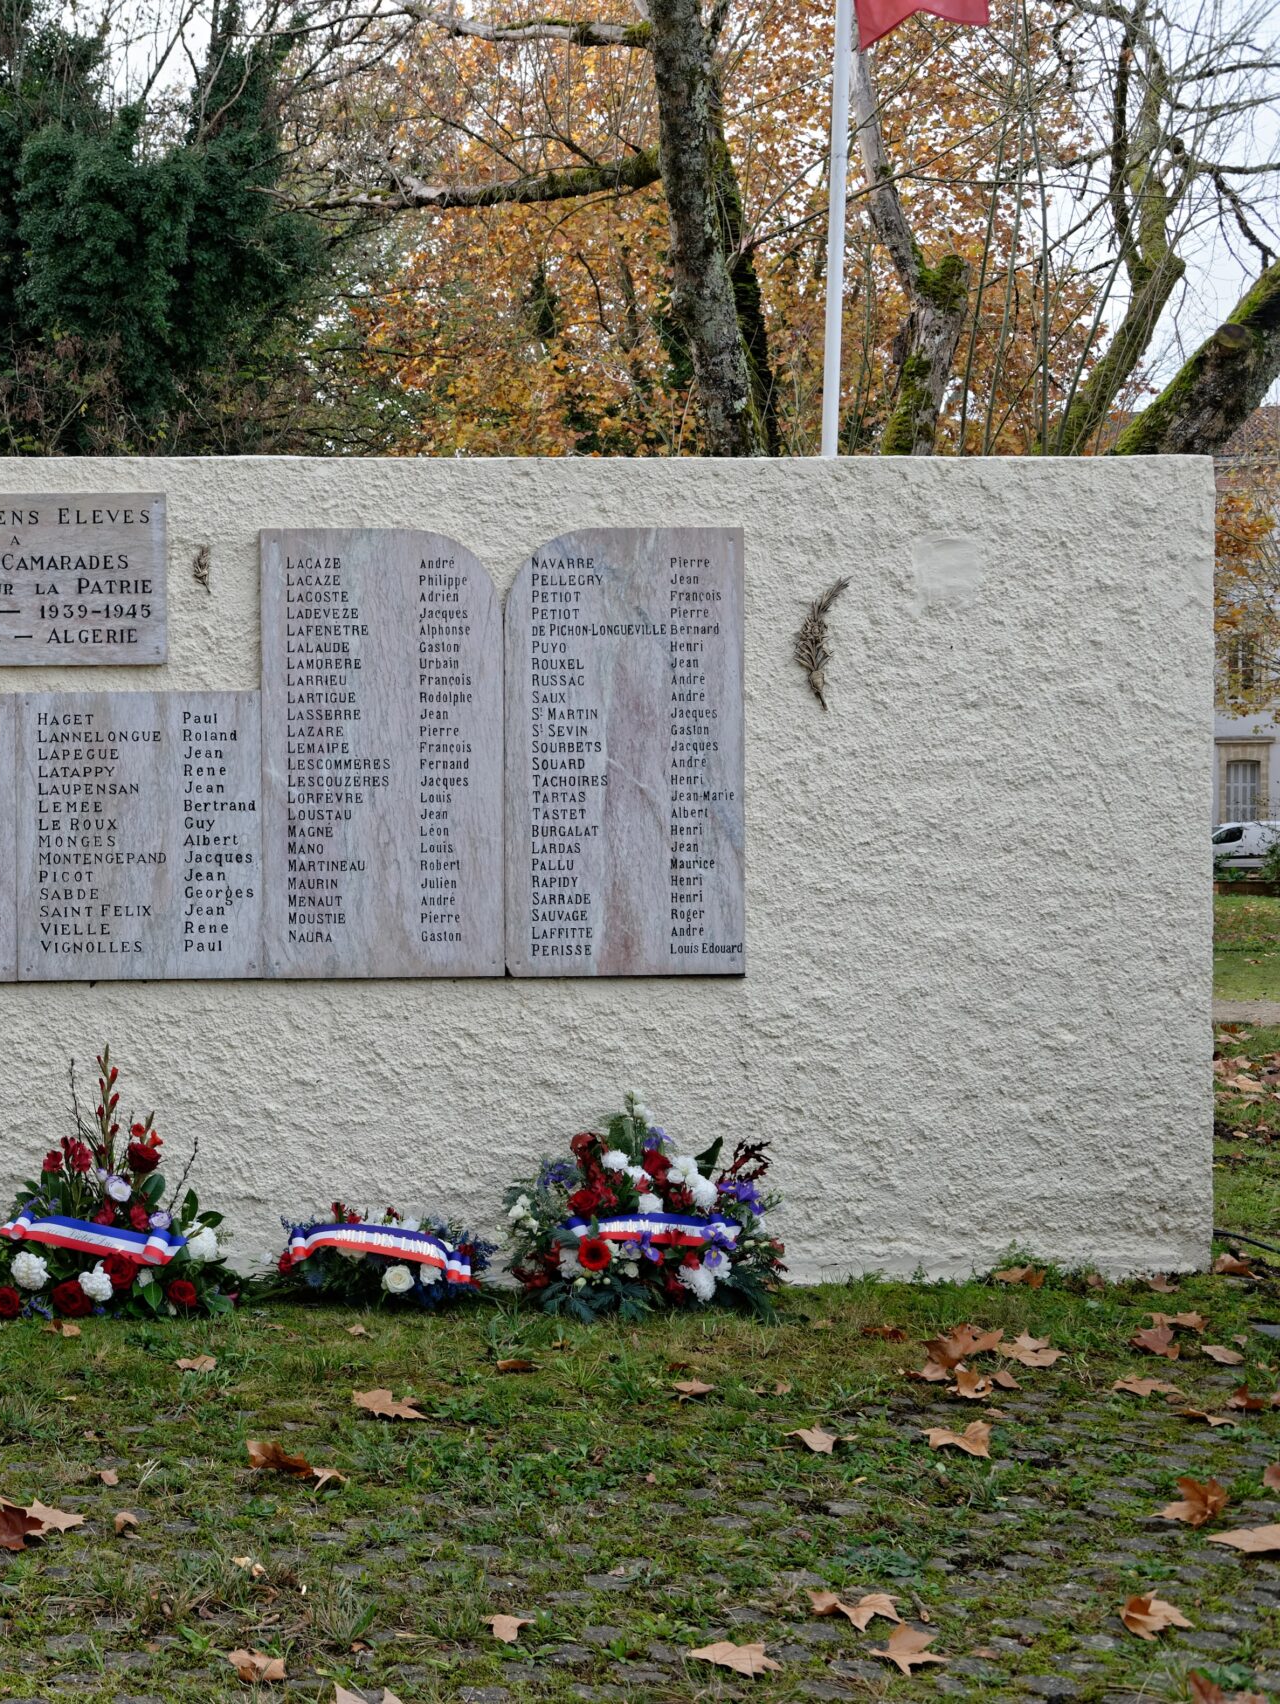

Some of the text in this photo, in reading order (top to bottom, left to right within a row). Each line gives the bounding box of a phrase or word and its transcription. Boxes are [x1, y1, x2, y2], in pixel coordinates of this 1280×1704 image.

[58, 508, 150, 524] ELEVES
[10, 535, 20, 545] A
[2, 554, 128, 571] CAMARADES
[532, 558, 710, 569] NAVARRE Pierre
[36, 583, 59, 595] LA
[77, 578, 152, 594] PATRIE
[287, 574, 467, 589] LACAZE Philippe
[532, 574, 699, 586] PELLEGRY Jean
[287, 590, 459, 602] LACOSTE Adrien
[40, 604, 151, 619] 1939-1945
[532, 608, 709, 620] PETIOT Pierre
[47, 628, 137, 644] ALGERIE
[287, 641, 459, 653] LALAUDE Gaston
[533, 641, 703, 653] PUYO Henri
[532, 658, 699, 670] ROUXEL Jean
[288, 692, 472, 706] LARTIGUE Rodolphe
[38, 712, 218, 725] HAGET Paul
[288, 709, 448, 720] LASSERRE Jean
[38, 730, 237, 743] LANNELONGUE Roland
[288, 726, 459, 737] LAZARE Pierre
[533, 741, 718, 753] SOURBETS Jacques
[38, 767, 115, 778] LATAPPY
[38, 782, 224, 795] LAUPENSAN Jean
[533, 790, 735, 803] TARTAS Jean-Marie
[39, 800, 256, 813] LEMEE Bertrand
[288, 809, 447, 820] LOUSTAU Jean
[39, 818, 215, 831] LE ROUX Guy
[532, 824, 702, 837] BURGALAT Henri
[39, 835, 239, 847] MONGES Albert
[288, 842, 453, 854] MANO Louis
[289, 860, 460, 872] MARTINEAU Robert
[532, 858, 715, 871] PALLU Maurice
[39, 869, 225, 883] PICOT Jean
[289, 877, 456, 889] MAURIN Julien
[41, 887, 254, 906] SABDE Georges
[41, 904, 225, 917] SAINT FELIX Jean
[533, 909, 704, 922] SAUVAGE Roger
[289, 930, 462, 943] NAURA Gaston
[41, 940, 222, 953] VIGNOLLES Paul
